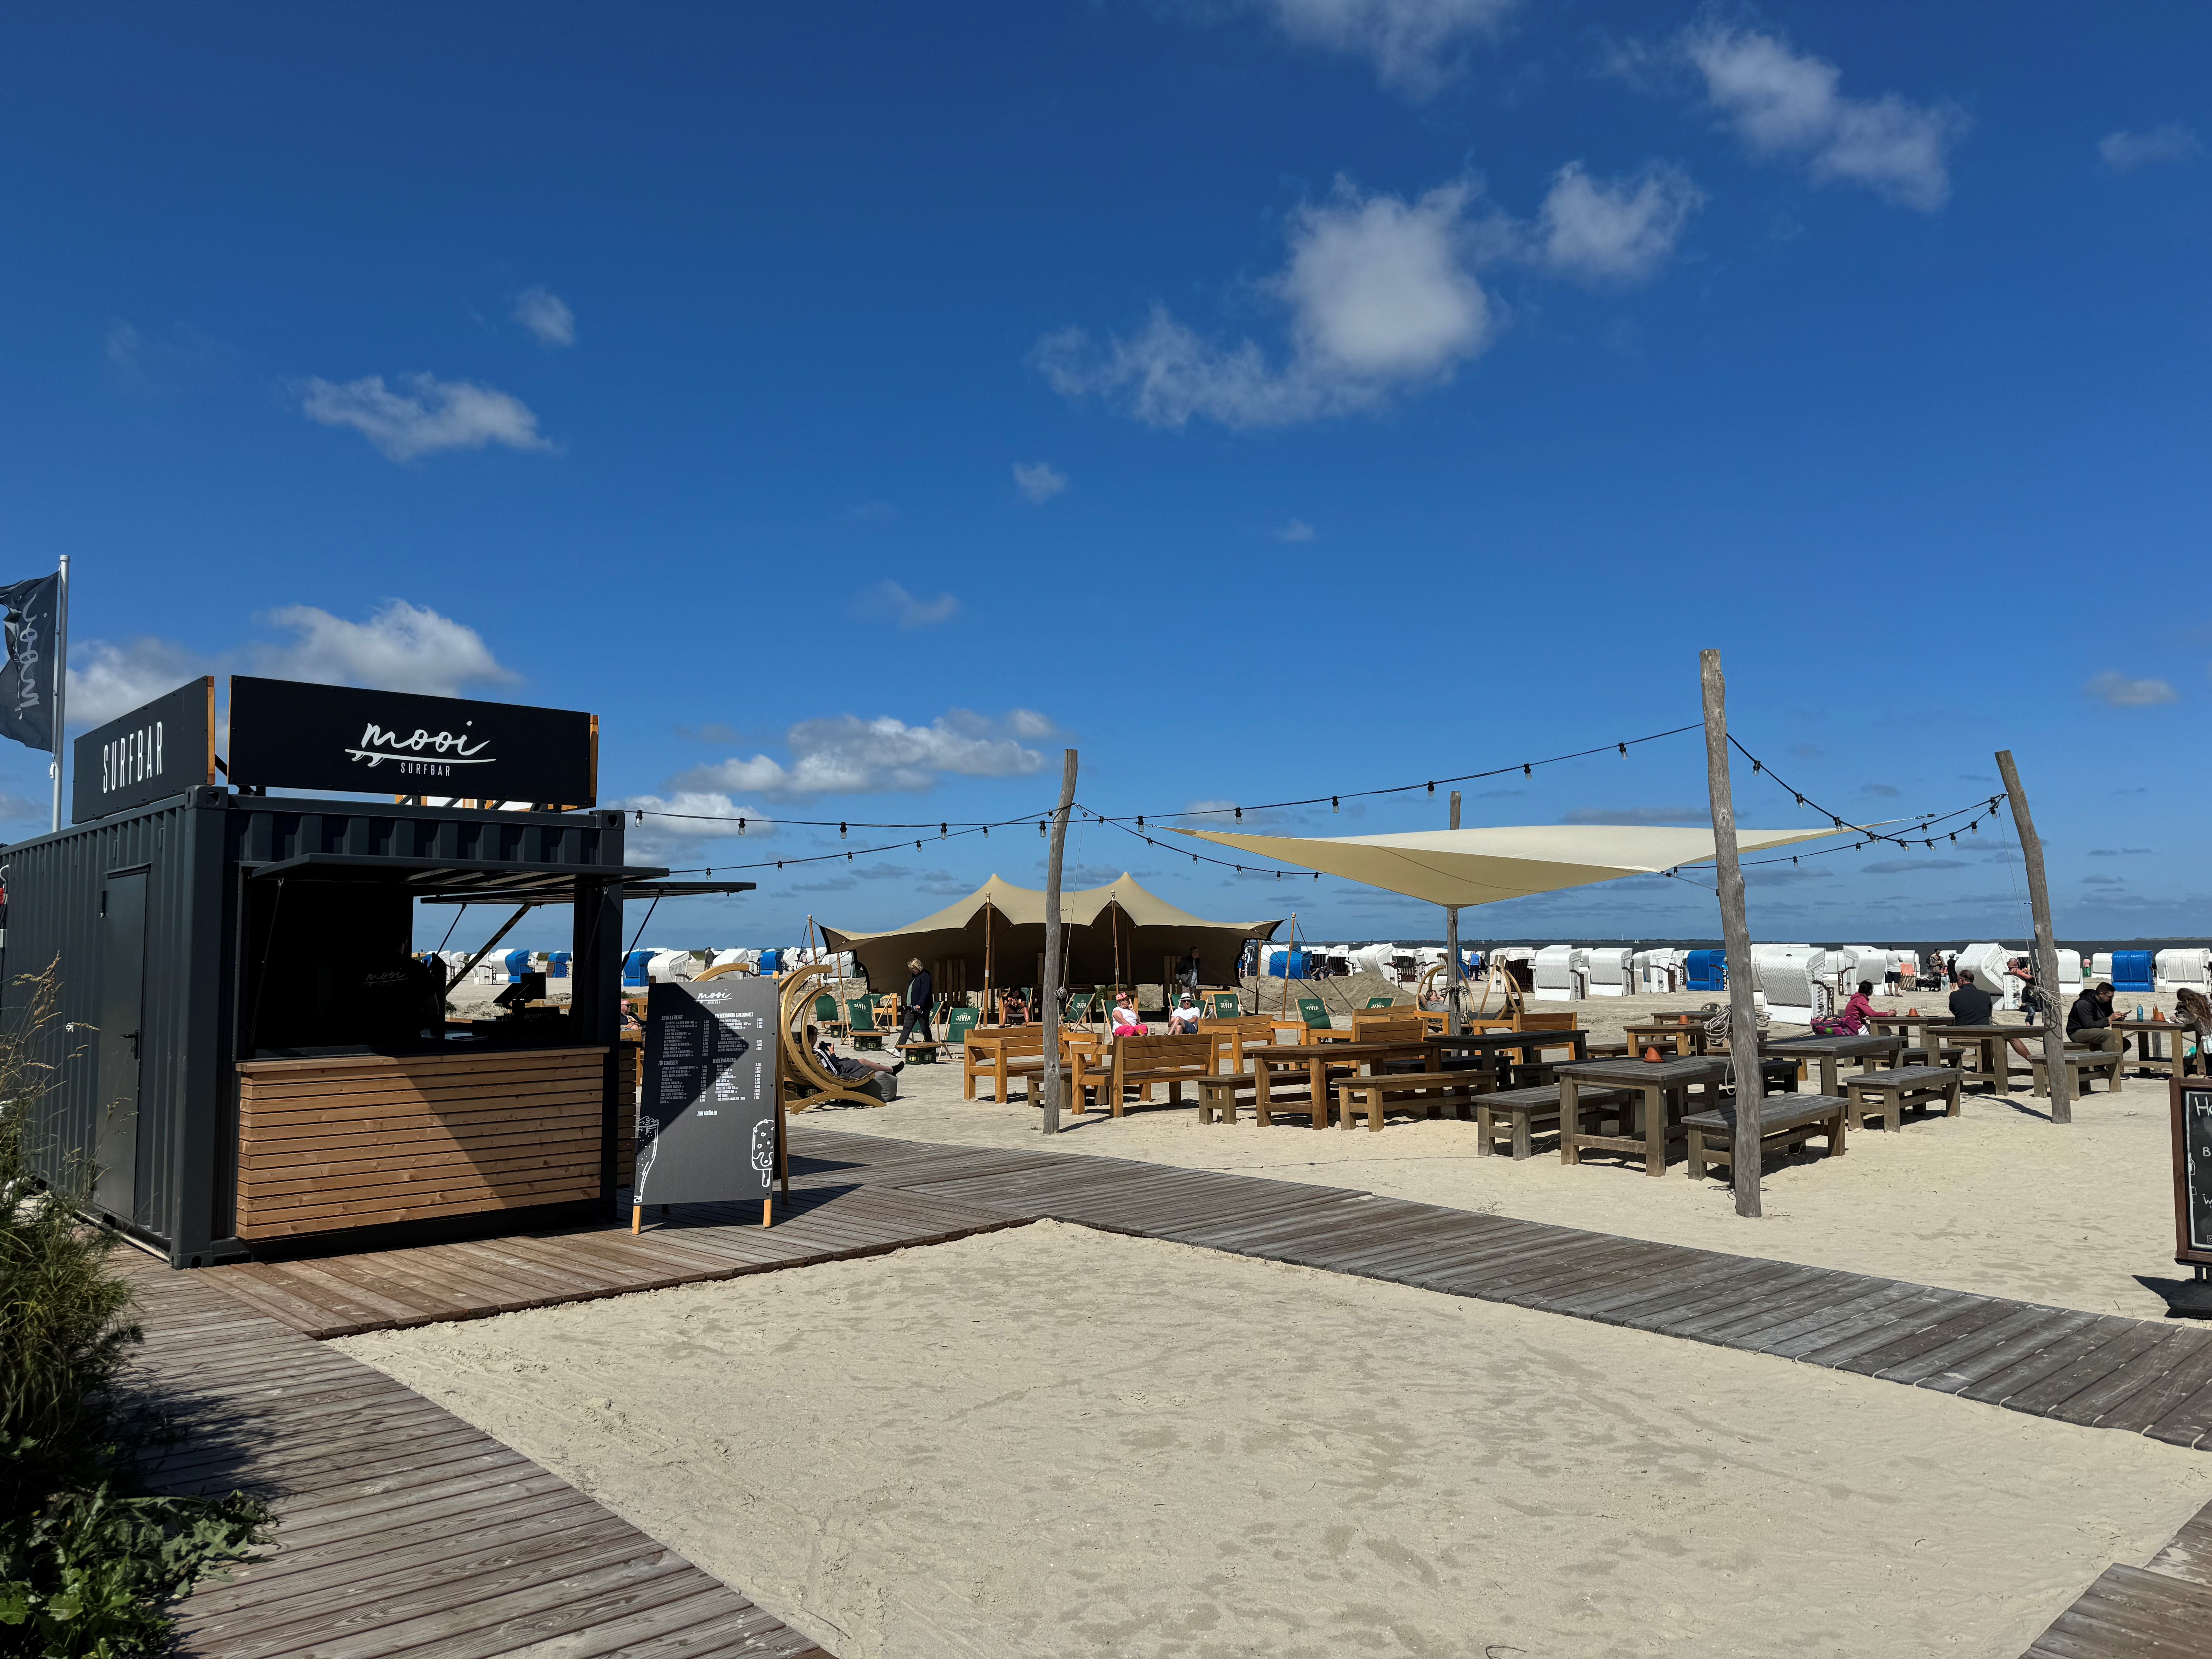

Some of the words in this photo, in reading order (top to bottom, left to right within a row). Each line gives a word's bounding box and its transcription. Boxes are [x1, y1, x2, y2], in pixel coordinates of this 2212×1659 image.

[361, 720, 490, 756] mooi
[103, 721, 162, 793] SURFBAR
[401, 762, 450, 776] SURFBAR
[366, 967, 407, 981] mooi
[697, 988, 732, 999] mooi
[805, 1089, 817, 1097] JEVER
